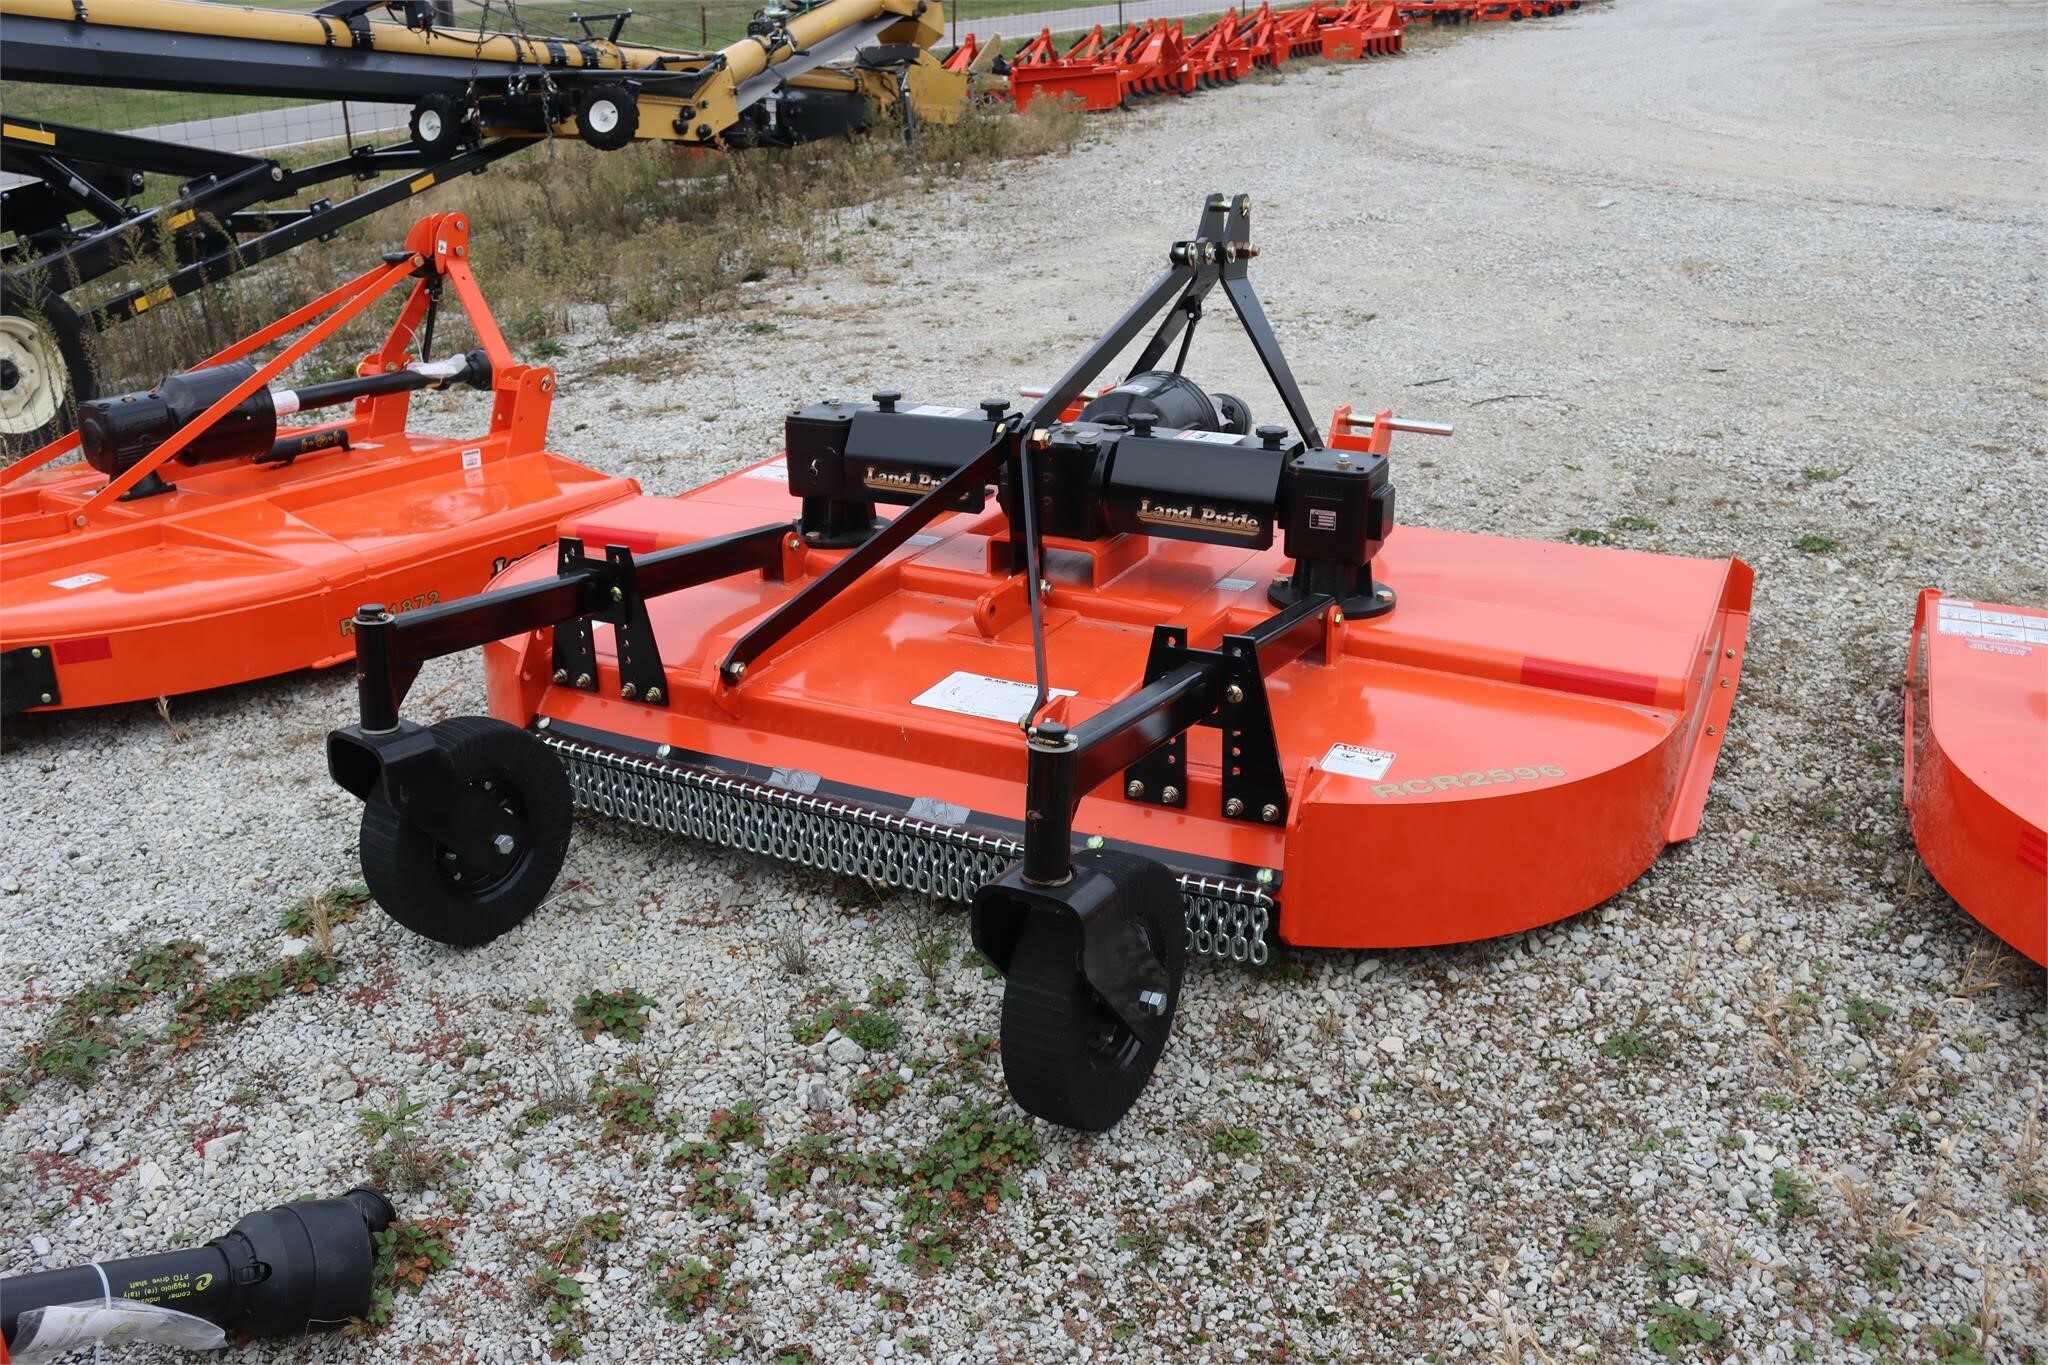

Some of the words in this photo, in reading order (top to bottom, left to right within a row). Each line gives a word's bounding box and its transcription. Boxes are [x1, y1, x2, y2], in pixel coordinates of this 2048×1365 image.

[864, 466, 912, 487] Land
[1139, 499, 1194, 520] Land
[1201, 506, 1259, 531] Pride
[984, 677, 1008, 685] BLADE
[1345, 745, 1393, 759] DANGER
[1369, 763, 1568, 800] RCR2596
[152, 1276, 170, 1284] drive
[173, 1273, 189, 1281] PTO
[129, 1280, 148, 1289] shaft
[160, 1282, 190, 1292] reggiolo
[123, 1290, 141, 1299] italy
[144, 1286, 158, 1296] (re)
[167, 1290, 191, 1300] comer
